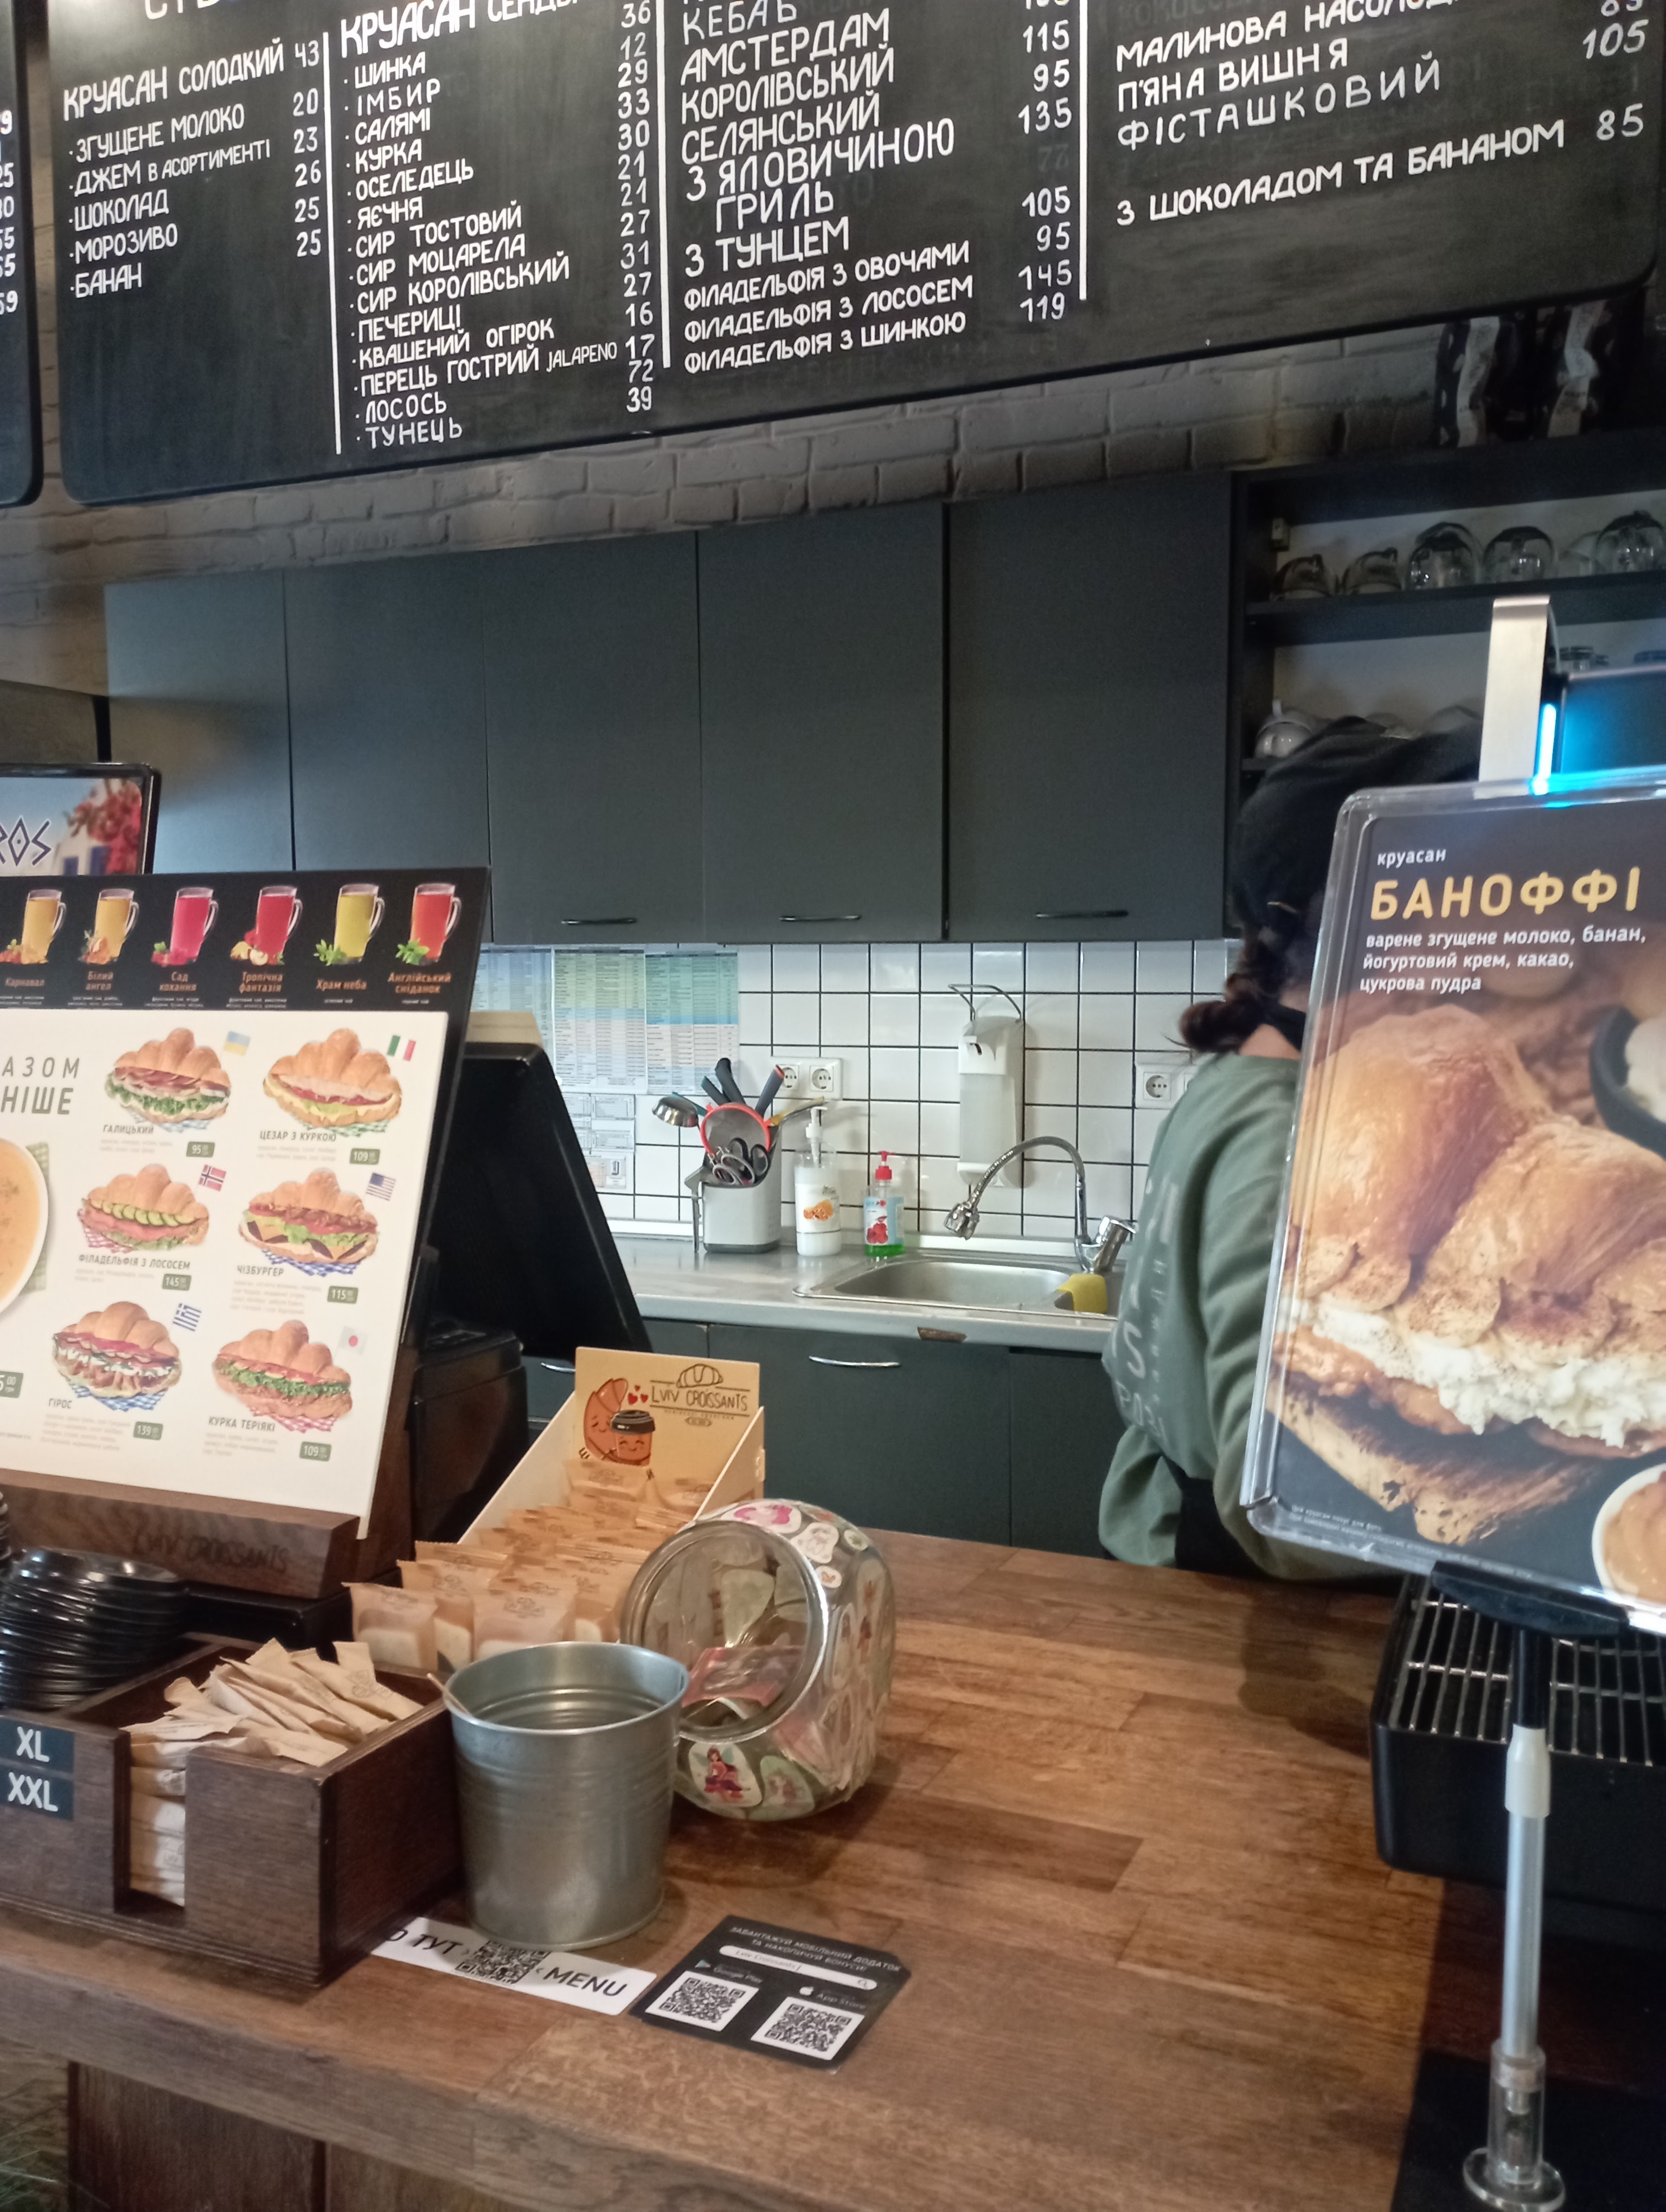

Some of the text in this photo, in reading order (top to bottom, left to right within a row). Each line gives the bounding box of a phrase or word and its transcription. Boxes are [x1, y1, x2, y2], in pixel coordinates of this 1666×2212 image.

[341, 0, 476, 59] КРУАСАН
[355, 0, 651, 89] ШИНКА 36
[680, 7, 889, 86] АМСТЕРДАМ
[1116, 10, 1286, 72] МАЛИНОВА
[63, 37, 320, 121] КРУАСАН СОЛОДКИЙ 43
[355, 59, 648, 145] САЛЯМІ 29
[357, 31, 646, 117] ІМБИР 12
[682, 19, 1069, 124] КОРОЛІВСЬКИЙ 115
[1118, 37, 1348, 112] П'ЯНА ВИШНЯ
[1118, 19, 1649, 151] ФІСТАШКОВИЙ 105
[76, 87, 318, 163] ЗГУЩЕНЕ МОЛОКО 20
[355, 87, 650, 175] КУРКА 33
[682, 59, 1070, 165] СЕЛЯНСЬКИЙ 95
[74, 126, 318, 197] ДЖЕМ В АСОРТИМЕНТІ 23
[355, 119, 650, 201] ОСЕЛЕДЕЦЬ 30
[686, 97, 1072, 201] З ЯЛОВИЧИНОЮ 135
[1117, 102, 1644, 226] З ШОКОЛАДОМ ТА БАНАНОМ 85
[74, 159, 322, 232] ШОКОЛАД 26
[355, 177, 646, 258] СИР ТОСТОВИЙ 21
[357, 150, 645, 230] ЯЄЧНЯ 21
[716, 181, 834, 233] ГРИЛЬ
[75, 196, 320, 265] МОРОЗИВО 25
[75, 228, 321, 298] БАНАН 25
[356, 209, 650, 286] СИР МОЦАРЕЛА 27
[685, 185, 1071, 278] З ТУНЦЕМ 105
[357, 240, 649, 314] СИР КОРОЛІВСЬКИЙ 31
[684, 221, 1071, 311] ФІЛАДЕЛЬФІЯ З ОВОЧАМИ 95
[358, 271, 652, 343] ПЕЧЕРИЦІ 27
[359, 301, 653, 370] КВАШЕНИЙ ОГІРОК 16
[684, 259, 1072, 343] ФІЛАДЕЛЬФІЯ З ЛОСОСЕМ 145
[684, 292, 1065, 374] ФІЛАДЕЛЬФІЯ З ШИНКОЮ 119
[361, 333, 655, 397] ПЕРЕЦЬ ГОСТРИЙ JALAPENO 17
[366, 358, 653, 424] ЛОСОСЬ 72
[365, 385, 652, 449] ТУНЕЦЬ 39
[1370, 866, 1641, 921] БАНОФФІ
[1377, 849, 1446, 869] круасан
[1363, 952, 1574, 972] йогуртовий крем, какао,
[1366, 924, 1646, 951] варене згущене молоко, банан,
[1360, 976, 1482, 994] цукрова пудра
[191, 1144, 201, 1154] 95
[260, 1130, 336, 1142] ЦЕЗАР З КУРКОЮ
[79, 1254, 191, 1270] ФІЛАДЕЛЬФІЯ З ЛОСОСЕМ
[165, 1277, 180, 1287] 145
[236, 1265, 284, 1276] ЧІЗБУРГЕР
[332, 1289, 346, 1300] 115
[48, 1398, 73, 1409] ГІРОС
[208, 1416, 275, 1432] КУРКА ТЕРІЯКІ
[651, 1385, 680, 1403] LVIV
[137, 1425, 151, 1436] 139
[304, 1445, 319, 1457] 109
[16, 1726, 50, 1763] XL
[8, 1771, 59, 1812] XXL
[412, 1933, 463, 1954] ТУТ
[731, 1926, 901, 1972] ЗАВАНТАЖУЙ МОБІЛЬНИЙ ДОДАТОК
[542, 1966, 627, 1997] MENU
